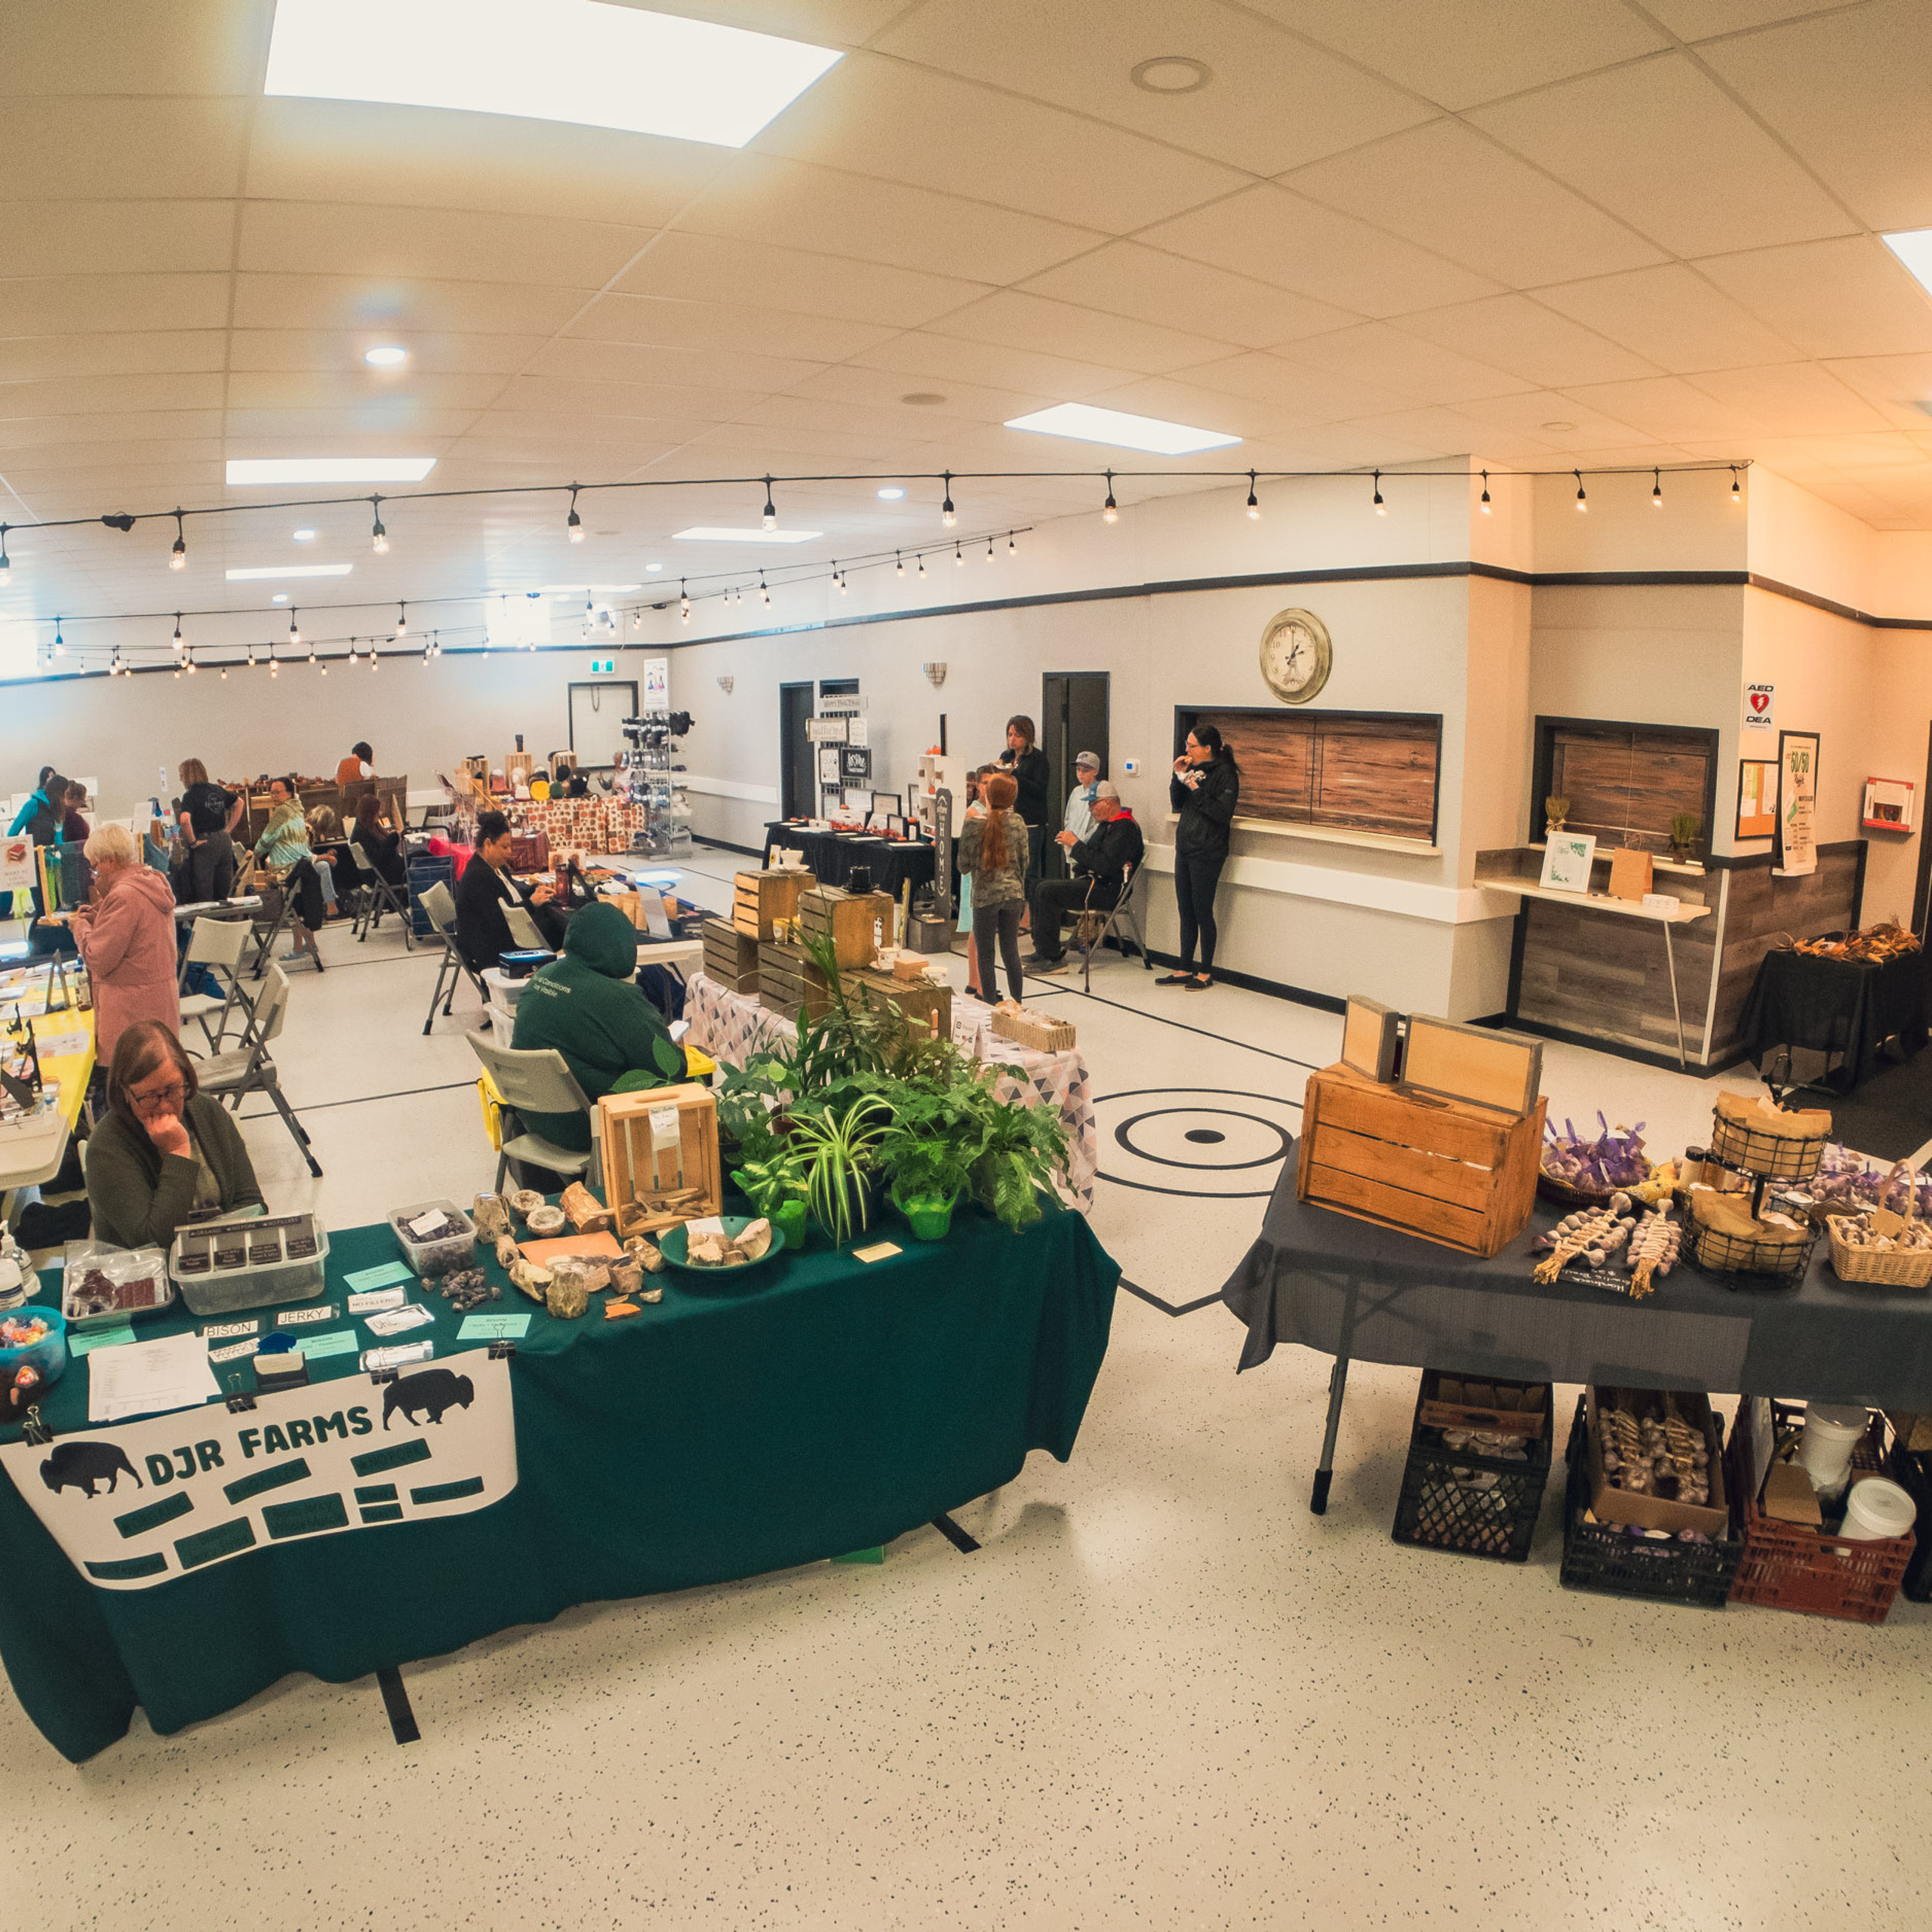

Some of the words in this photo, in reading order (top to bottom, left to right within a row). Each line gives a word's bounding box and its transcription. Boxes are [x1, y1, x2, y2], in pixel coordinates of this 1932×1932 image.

[1746, 716, 1771, 724] DEA
[1791, 751, 1810, 773] 50/50
[281, 1309, 324, 1323] JERKY
[207, 1322, 251, 1337] BISON
[145, 1439, 225, 1486] DJR
[238, 1406, 373, 1458] FARMS
